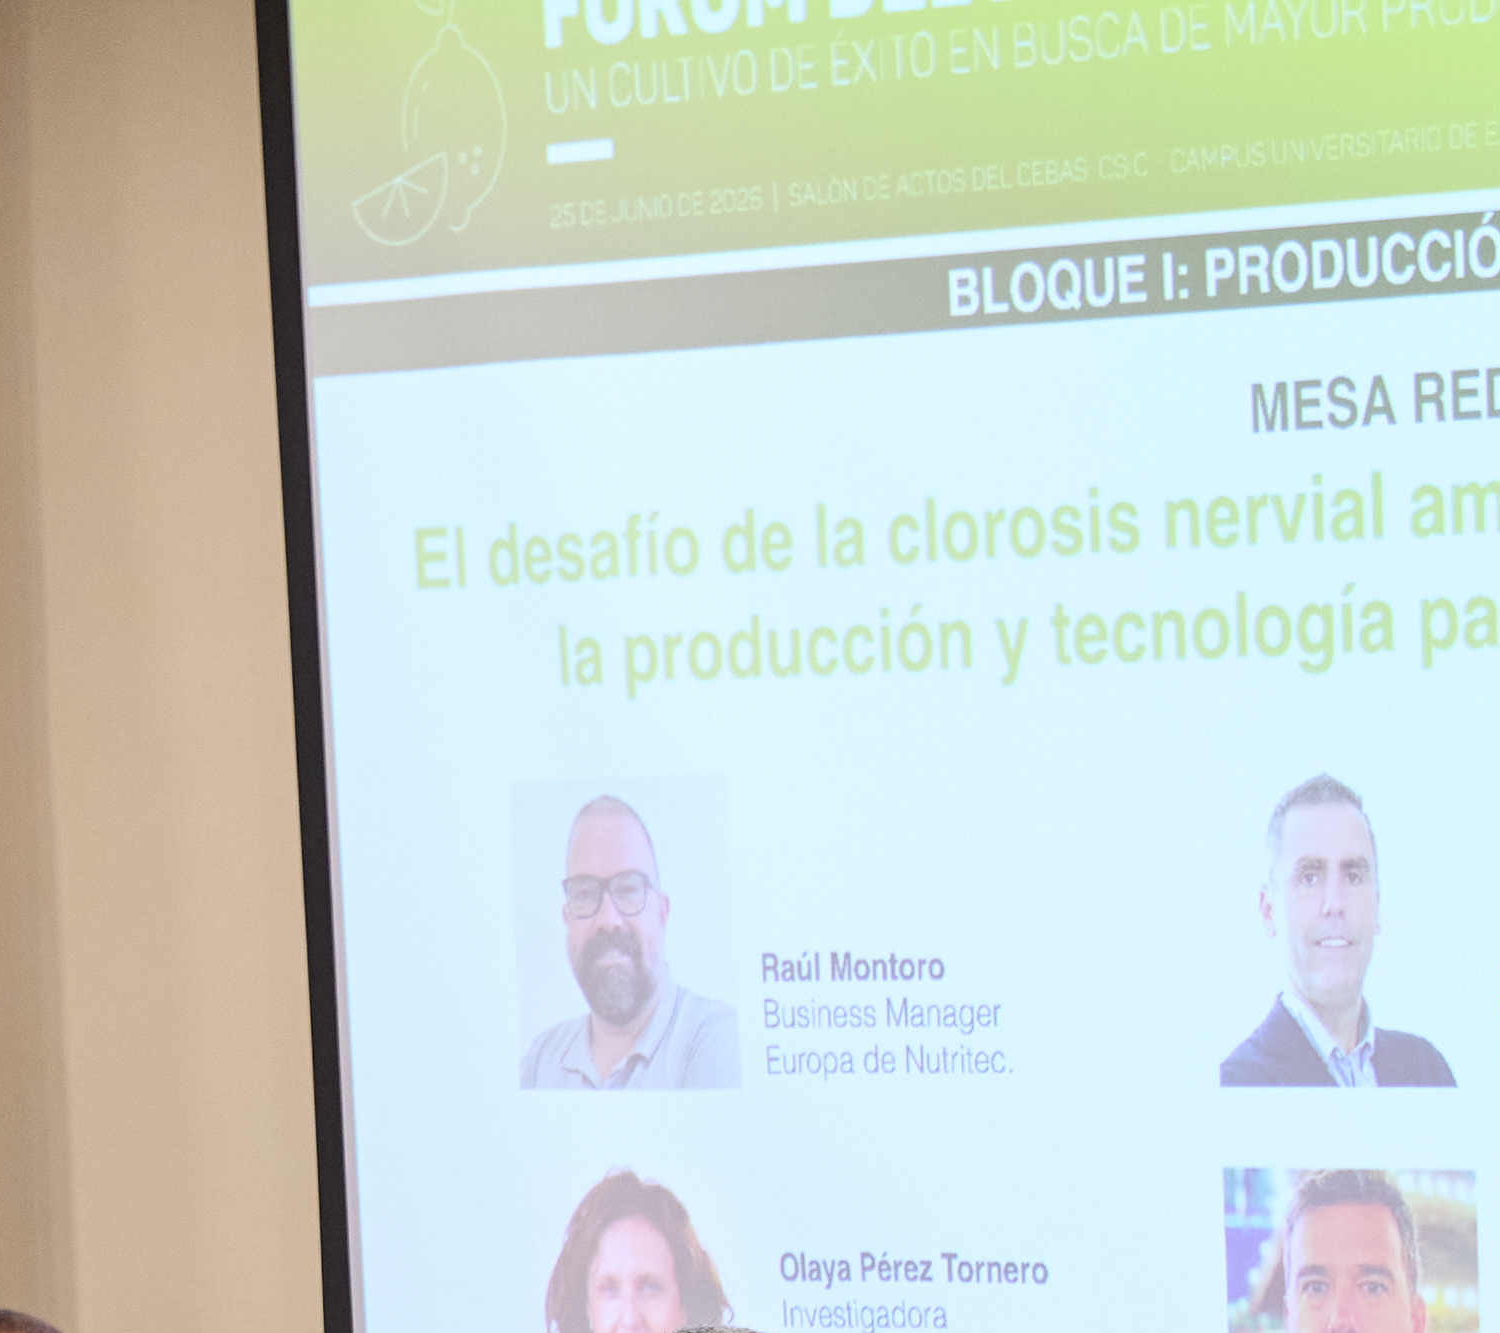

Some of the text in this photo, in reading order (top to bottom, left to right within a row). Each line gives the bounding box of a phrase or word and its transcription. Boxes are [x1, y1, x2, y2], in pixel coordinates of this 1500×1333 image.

[544, 67, 599, 114] UN
[606, 48, 759, 108] CULTIVO
[769, 44, 819, 92] DE
[831, 30, 938, 86] ÉXITO
[949, 26, 1001, 74] EN
[1013, 10, 1150, 70] BUSCA
[1159, 4, 1212, 53] DE
[1224, 0, 1368, 48] MAYOR
[550, 201, 577, 229] 25
[581, 198, 607, 225] DE
[611, 192, 674, 223] JUNIO
[677, 190, 705, 217] DE
[863, 174, 892, 201] DE
[896, 166, 965, 198] ACTOS
[972, 163, 1013, 193] DEL
[1170, 140, 1266, 175] CAMPUS
[1270, 126, 1442, 166] UNIVERSITARIO
[1449, 122, 1479, 150] DE
[947, 255, 1149, 319] BLOQUE
[1160, 250, 1191, 303] I:
[1250, 375, 1398, 434] MESA
[414, 525, 467, 590] El
[487, 509, 700, 588] desafío
[720, 508, 794, 575] de
[816, 503, 866, 570] la
[887, 486, 1141, 568] clorosis
[1164, 470, 1384, 549] nervial
[557, 624, 603, 687] la
[625, 602, 973, 700] producción
[994, 616, 1029, 686] y
[1050, 583, 1395, 677] tecnología
[761, 950, 946, 983] Raúl Montoro
[763, 996, 1002, 1035] Business Manager
[765, 1044, 1013, 1082] Europa de Nutritec.
[779, 1252, 1050, 1290] Olaya Pérez Tornero
